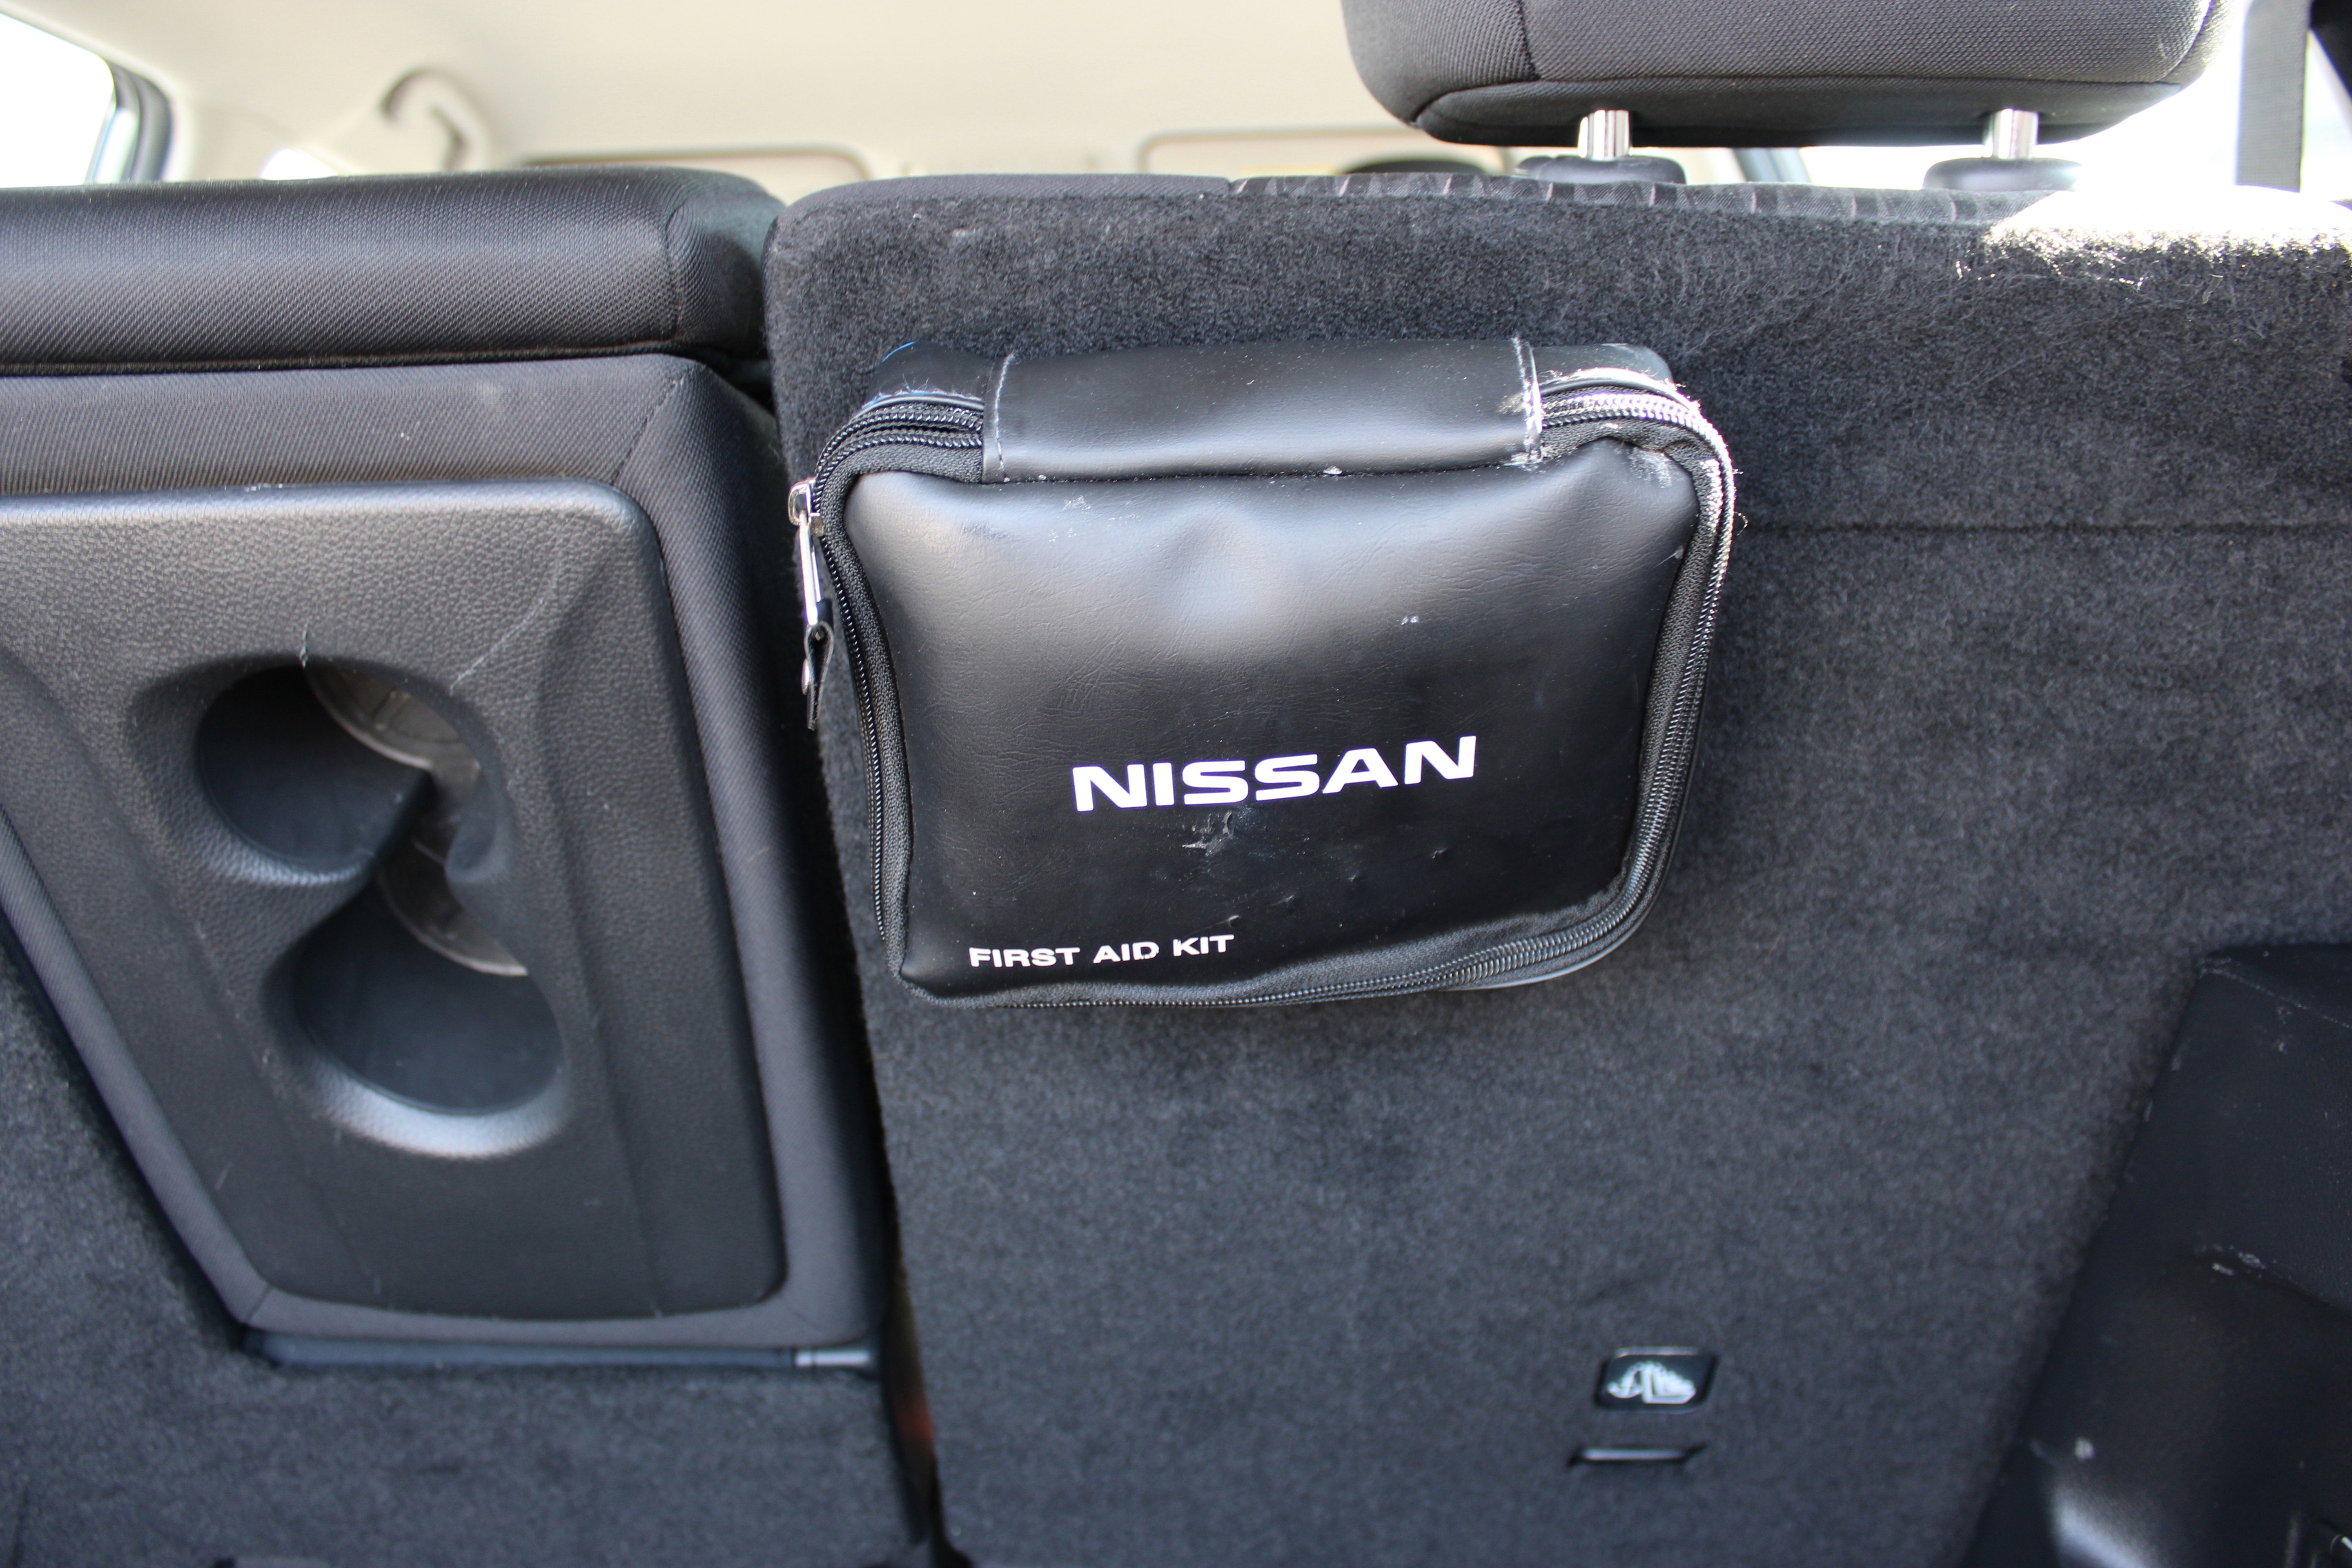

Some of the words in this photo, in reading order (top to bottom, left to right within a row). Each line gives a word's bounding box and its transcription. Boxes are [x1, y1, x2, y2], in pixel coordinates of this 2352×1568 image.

[1072, 735, 1477, 812] NISSAN
[968, 947, 1081, 968] FIRST
[1092, 943, 1160, 964] AID
[1172, 934, 1235, 957] KIT
